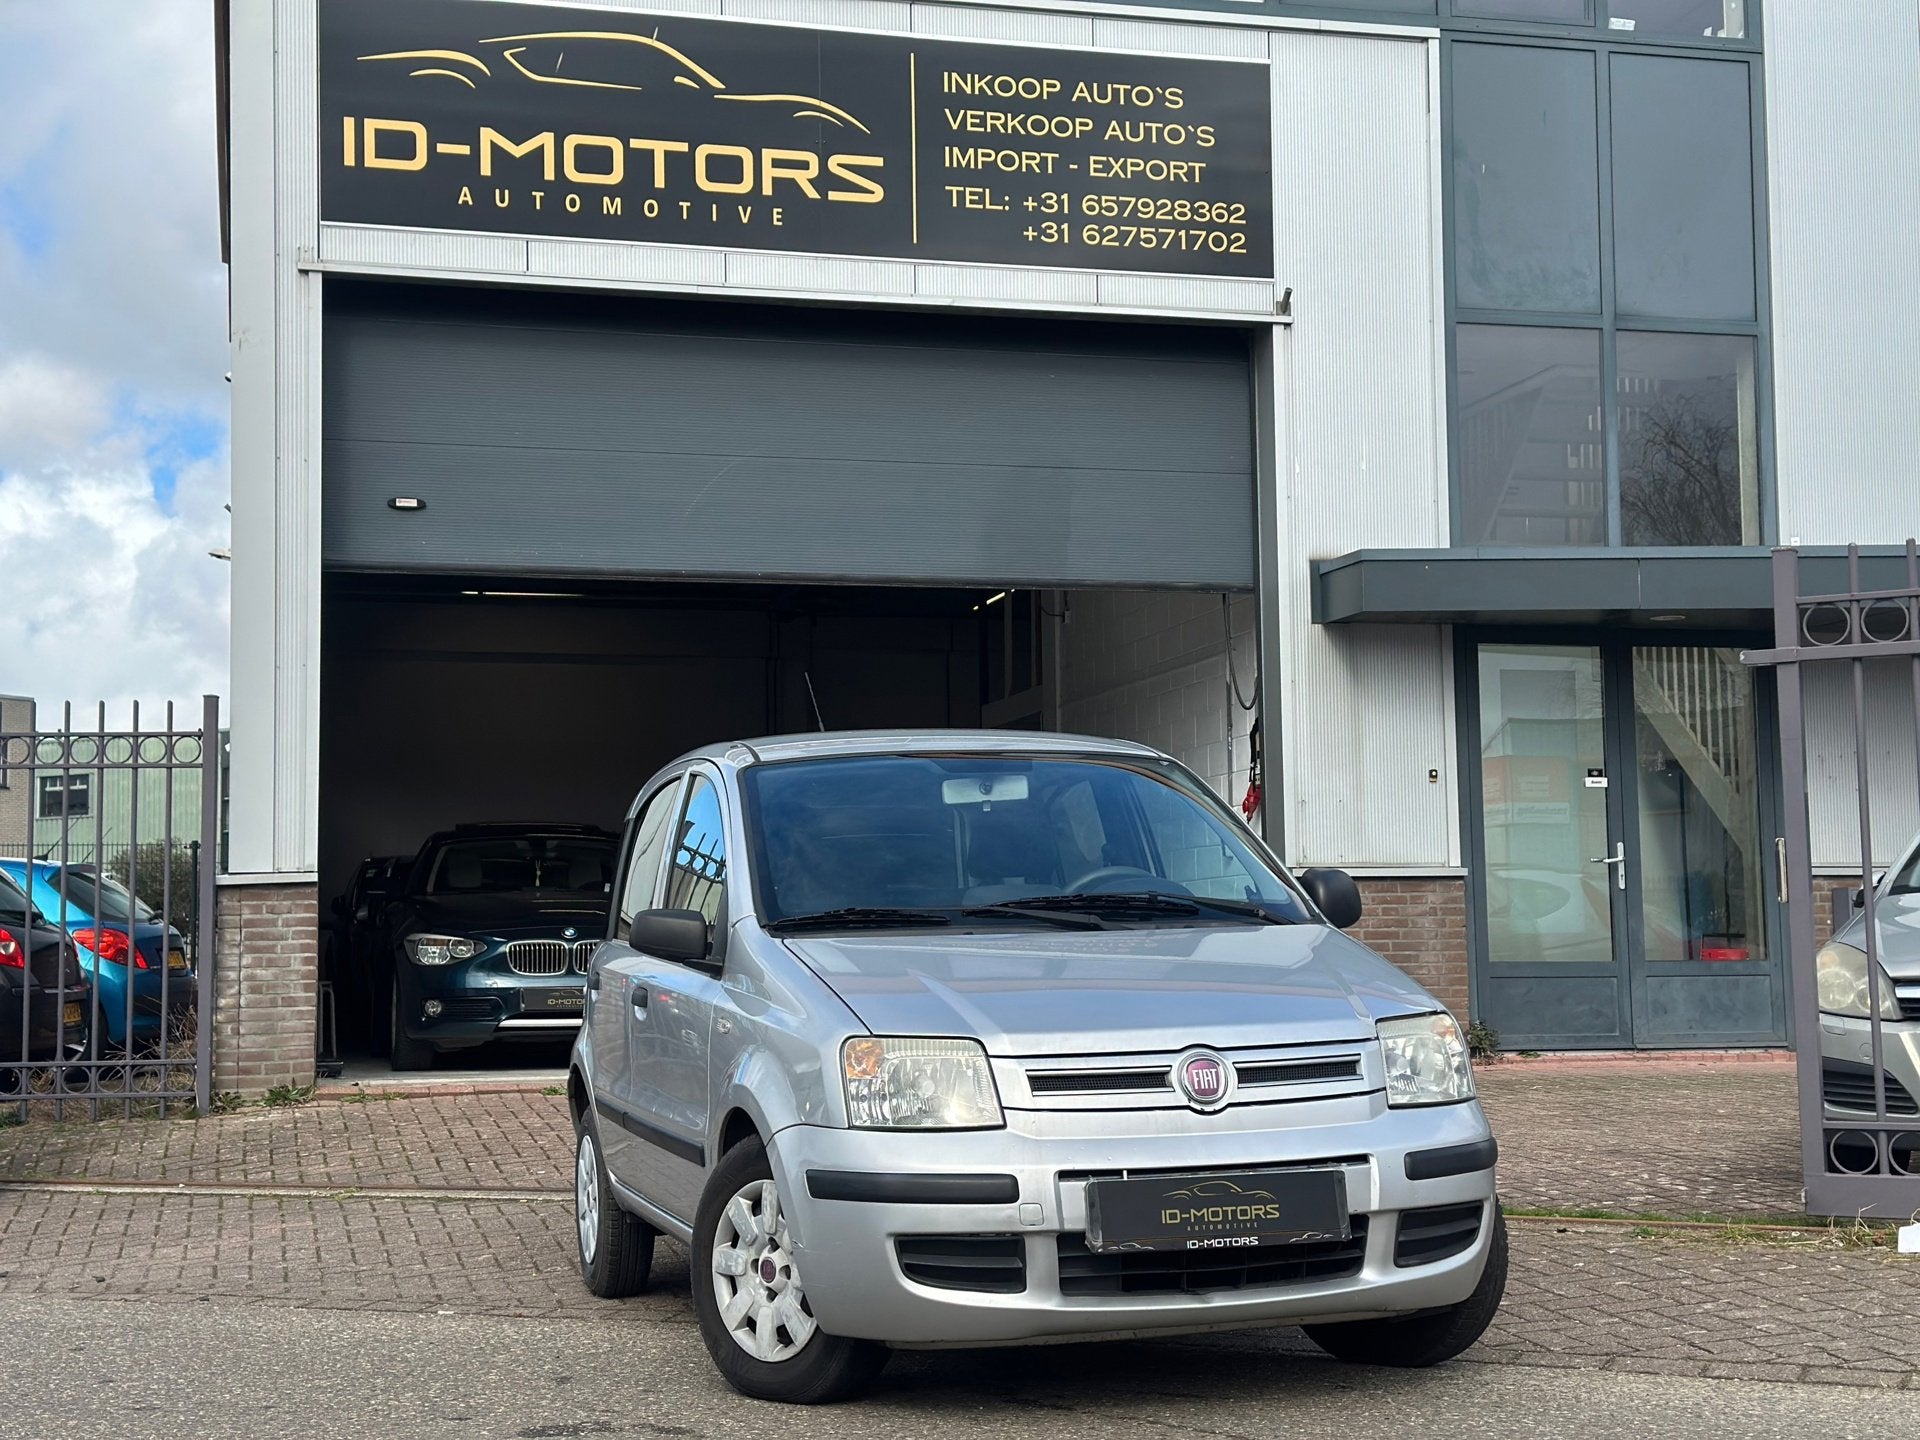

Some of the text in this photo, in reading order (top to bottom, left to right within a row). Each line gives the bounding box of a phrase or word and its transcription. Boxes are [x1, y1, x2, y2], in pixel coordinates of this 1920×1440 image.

[943, 71, 1061, 100] INKOOP
[944, 108, 1093, 139] VERKOOP
[343, 116, 884, 203] ID-MOTORS
[944, 146, 1060, 174] IMPORT
[1089, 155, 1206, 183] EXPORT
[458, 186, 784, 226] AUTOMOTIVE
[945, 185, 1247, 224] TEL: +31 657928362
[1023, 222, 1247, 254] +31 627571702
[1192, 1068, 1217, 1090] FIAT
[1161, 1203, 1280, 1224] ID-MOTORS
[1187, 1222, 1259, 1231] AUTOMOTIVE
[1186, 1236, 1259, 1249] ID-MOTORS
